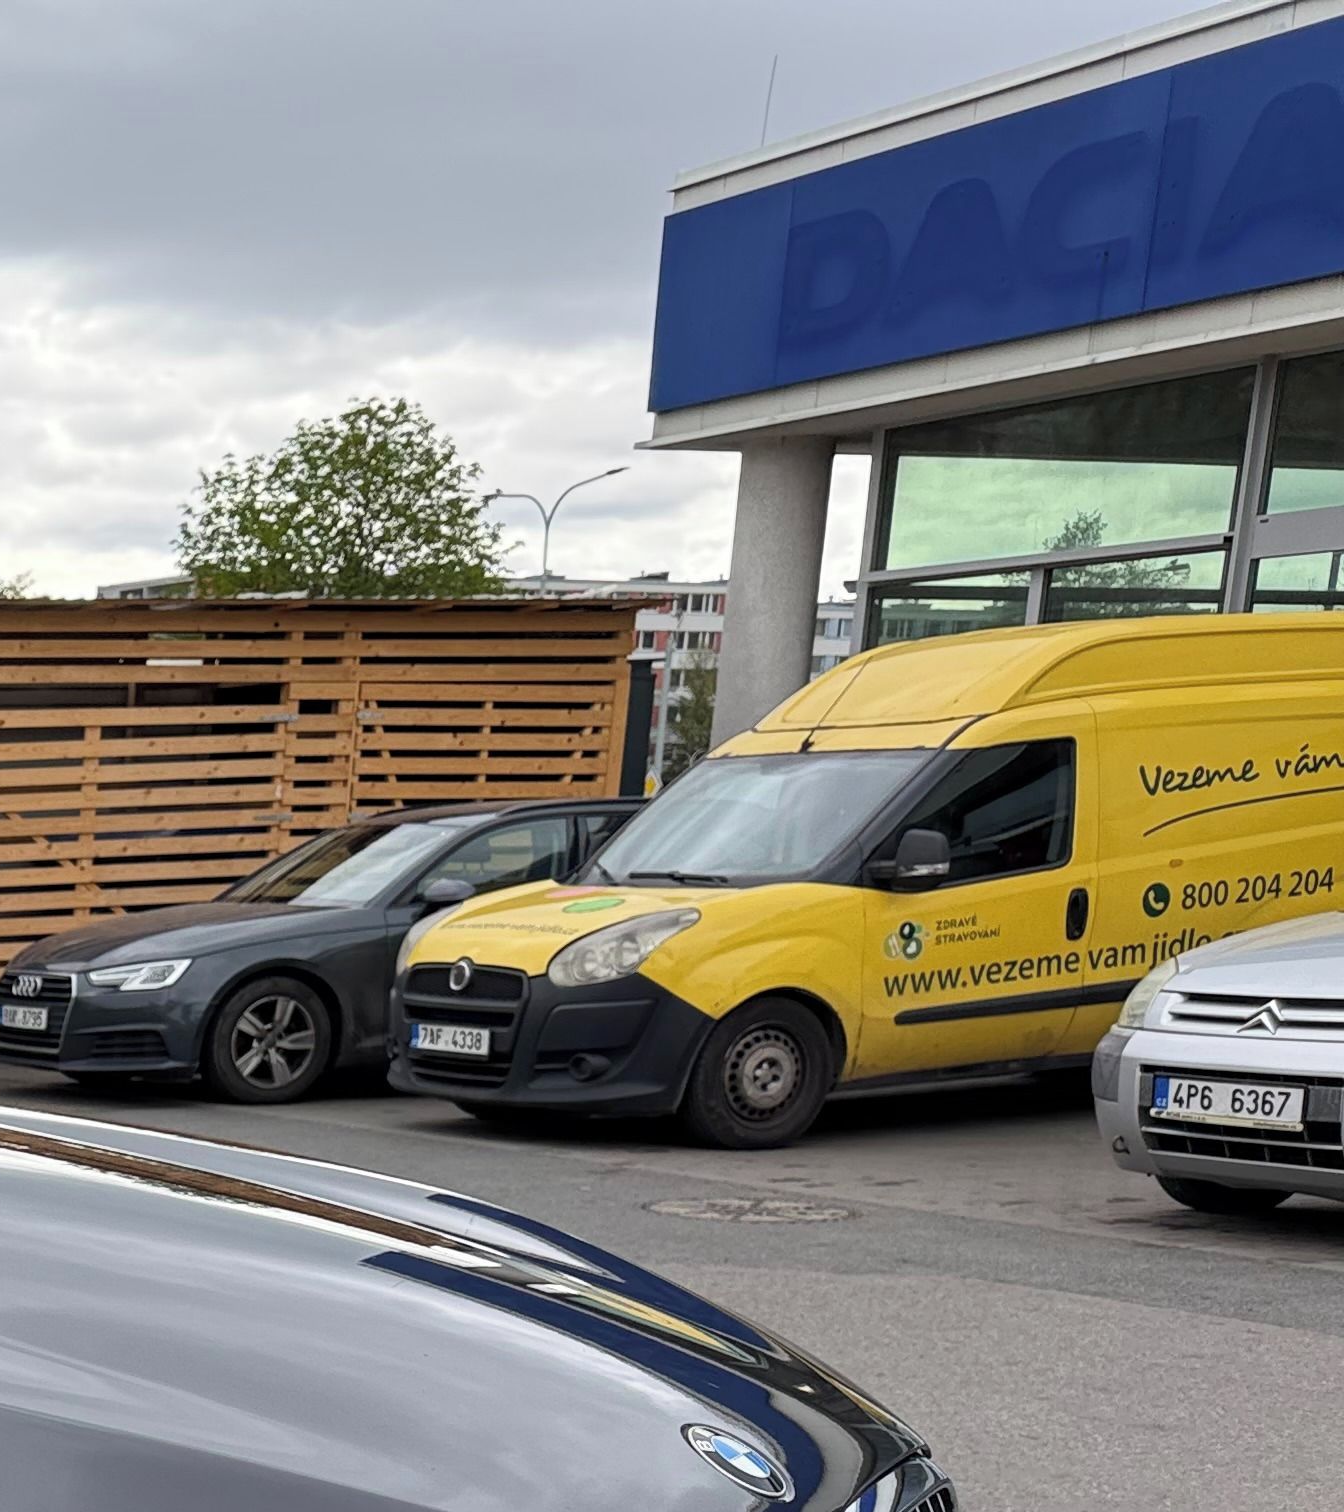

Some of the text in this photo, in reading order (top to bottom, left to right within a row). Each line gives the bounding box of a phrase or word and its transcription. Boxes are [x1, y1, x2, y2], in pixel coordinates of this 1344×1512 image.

[1139, 743, 1344, 796] Vezeme vám
[1181, 866, 1334, 910] 800 204 204
[935, 915, 977, 932] ZDRAVÉ
[421, 1026, 482, 1051] 7AF 4338
[1173, 1082, 1291, 1118] 4P6 6367
